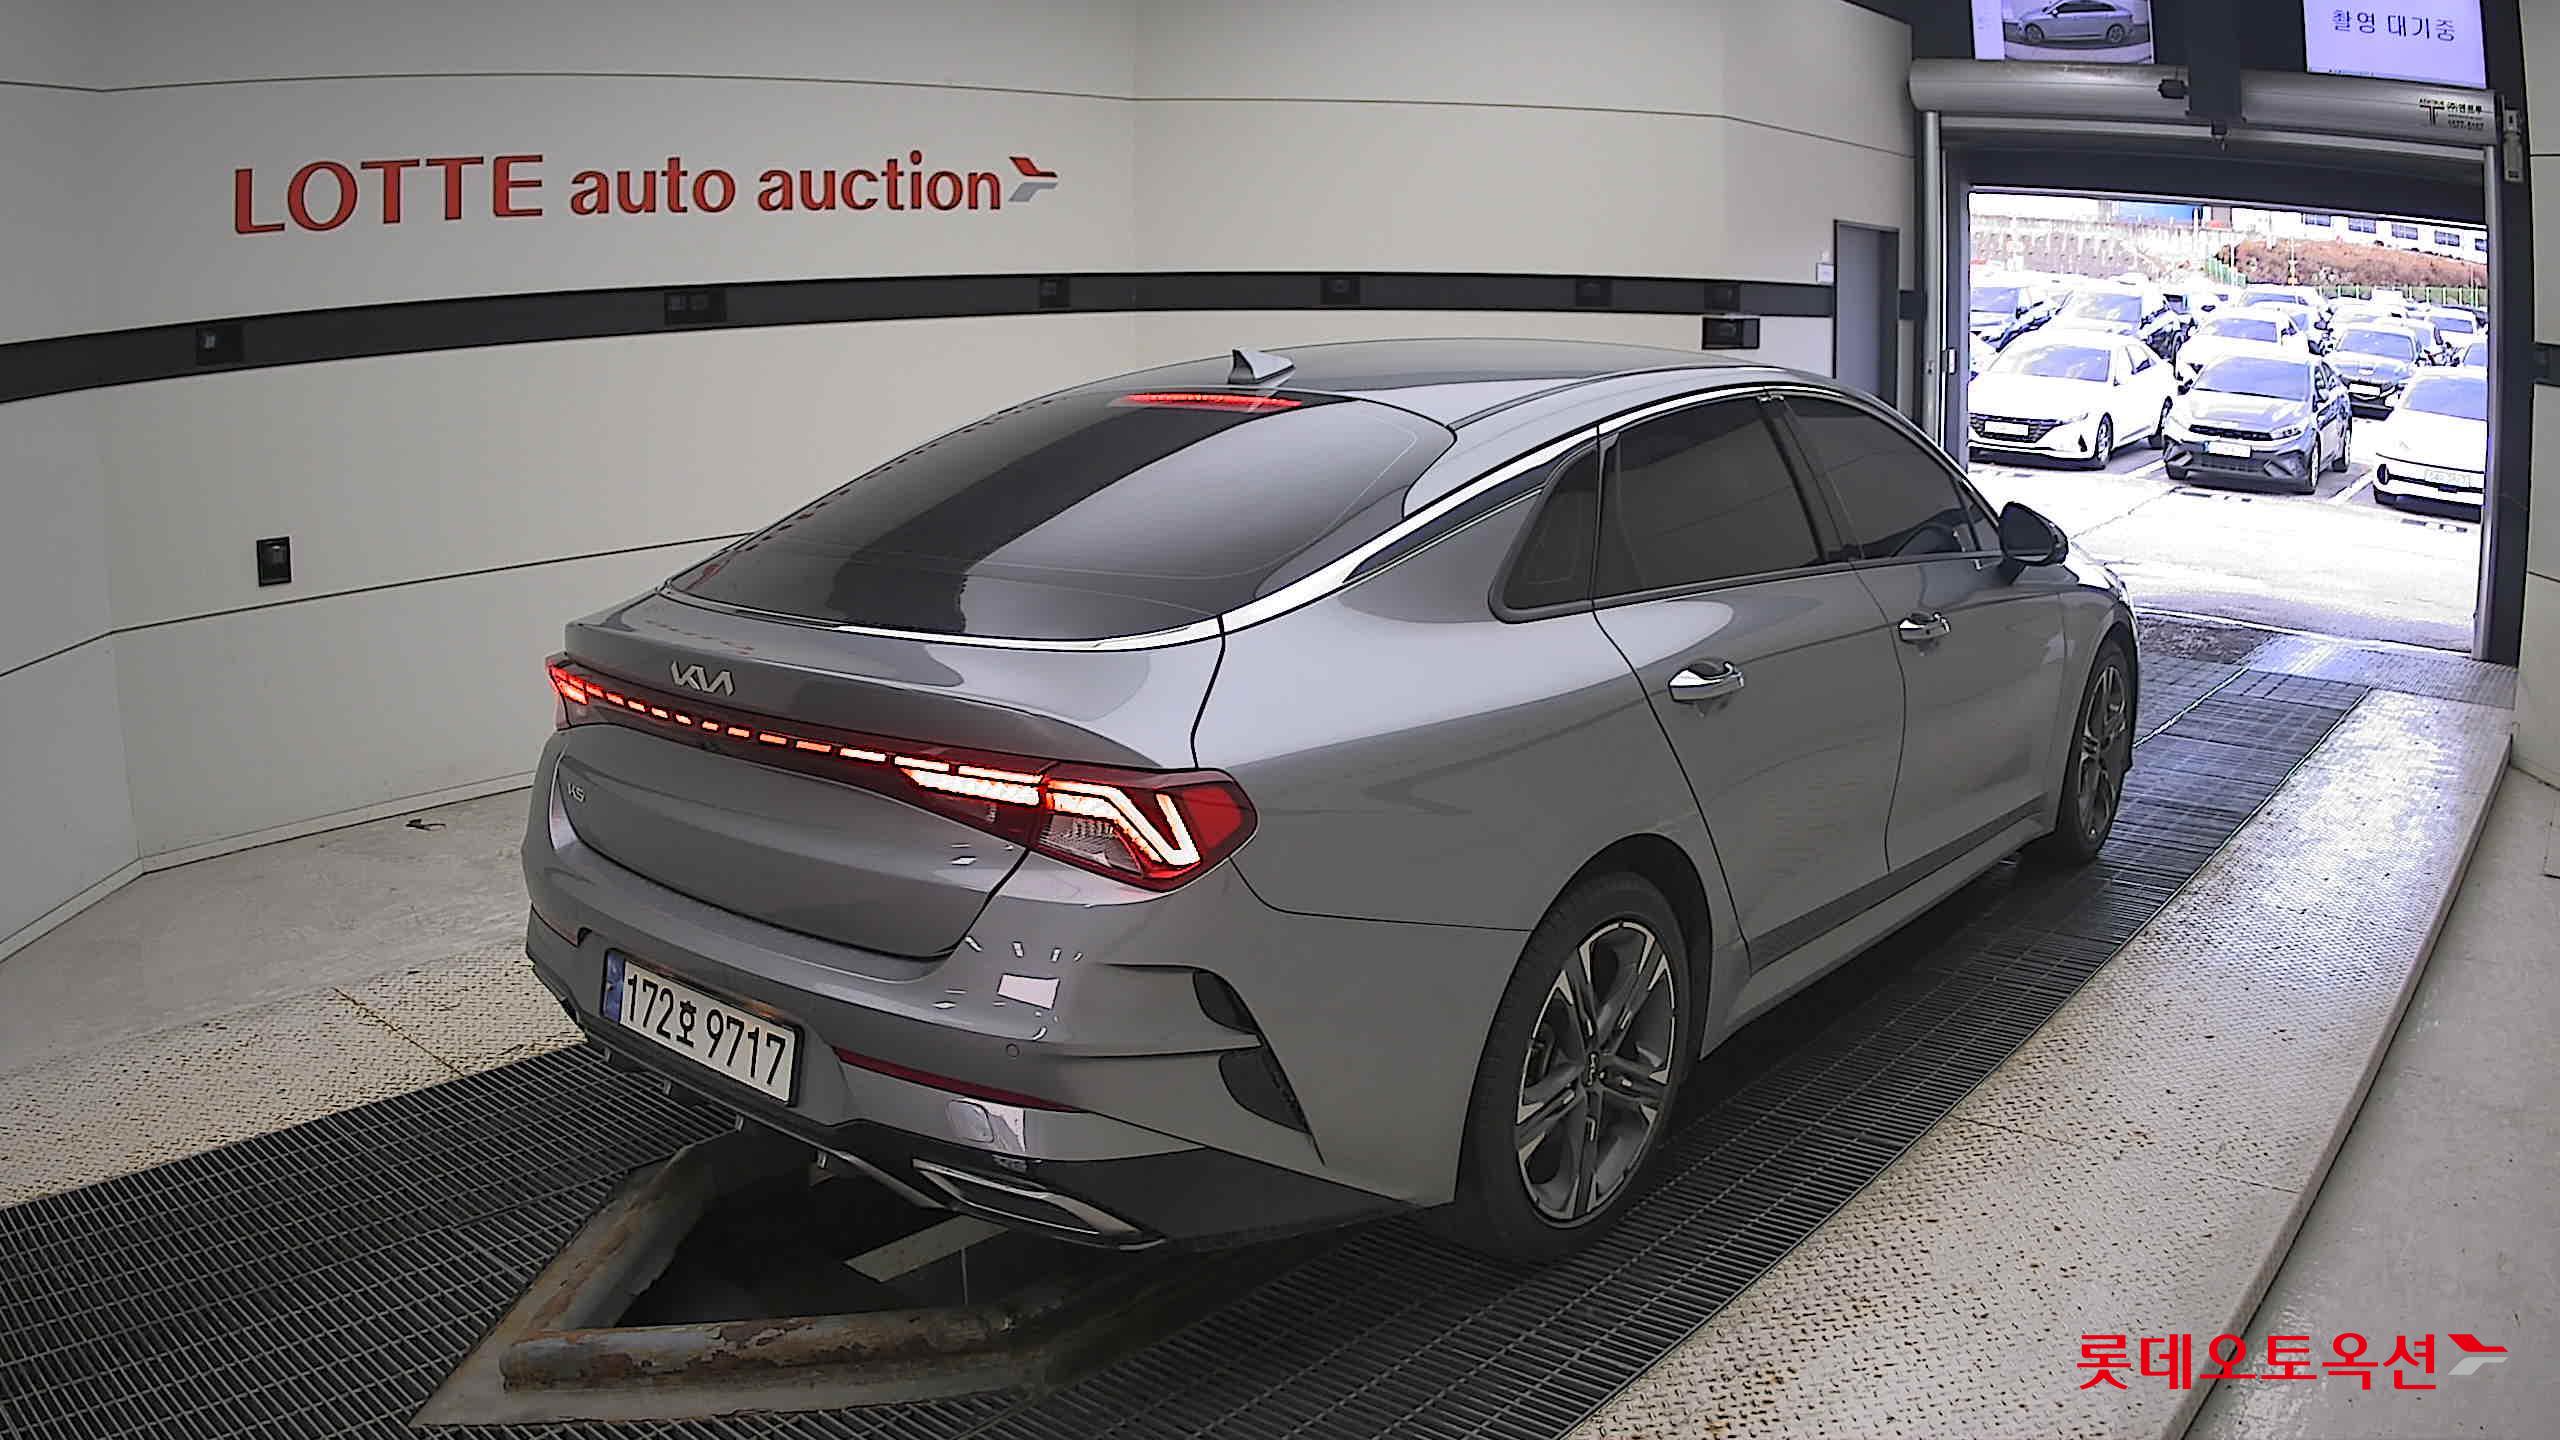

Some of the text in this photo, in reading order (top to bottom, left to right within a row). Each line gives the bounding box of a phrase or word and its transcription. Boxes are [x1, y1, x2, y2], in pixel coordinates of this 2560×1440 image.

[2332, 9, 2455, 42] 촬영 대기중
[235, 150, 1001, 234] LOTTE auto auction
[671, 660, 735, 696] KIA
[627, 974, 786, 1085] 172호 9717
